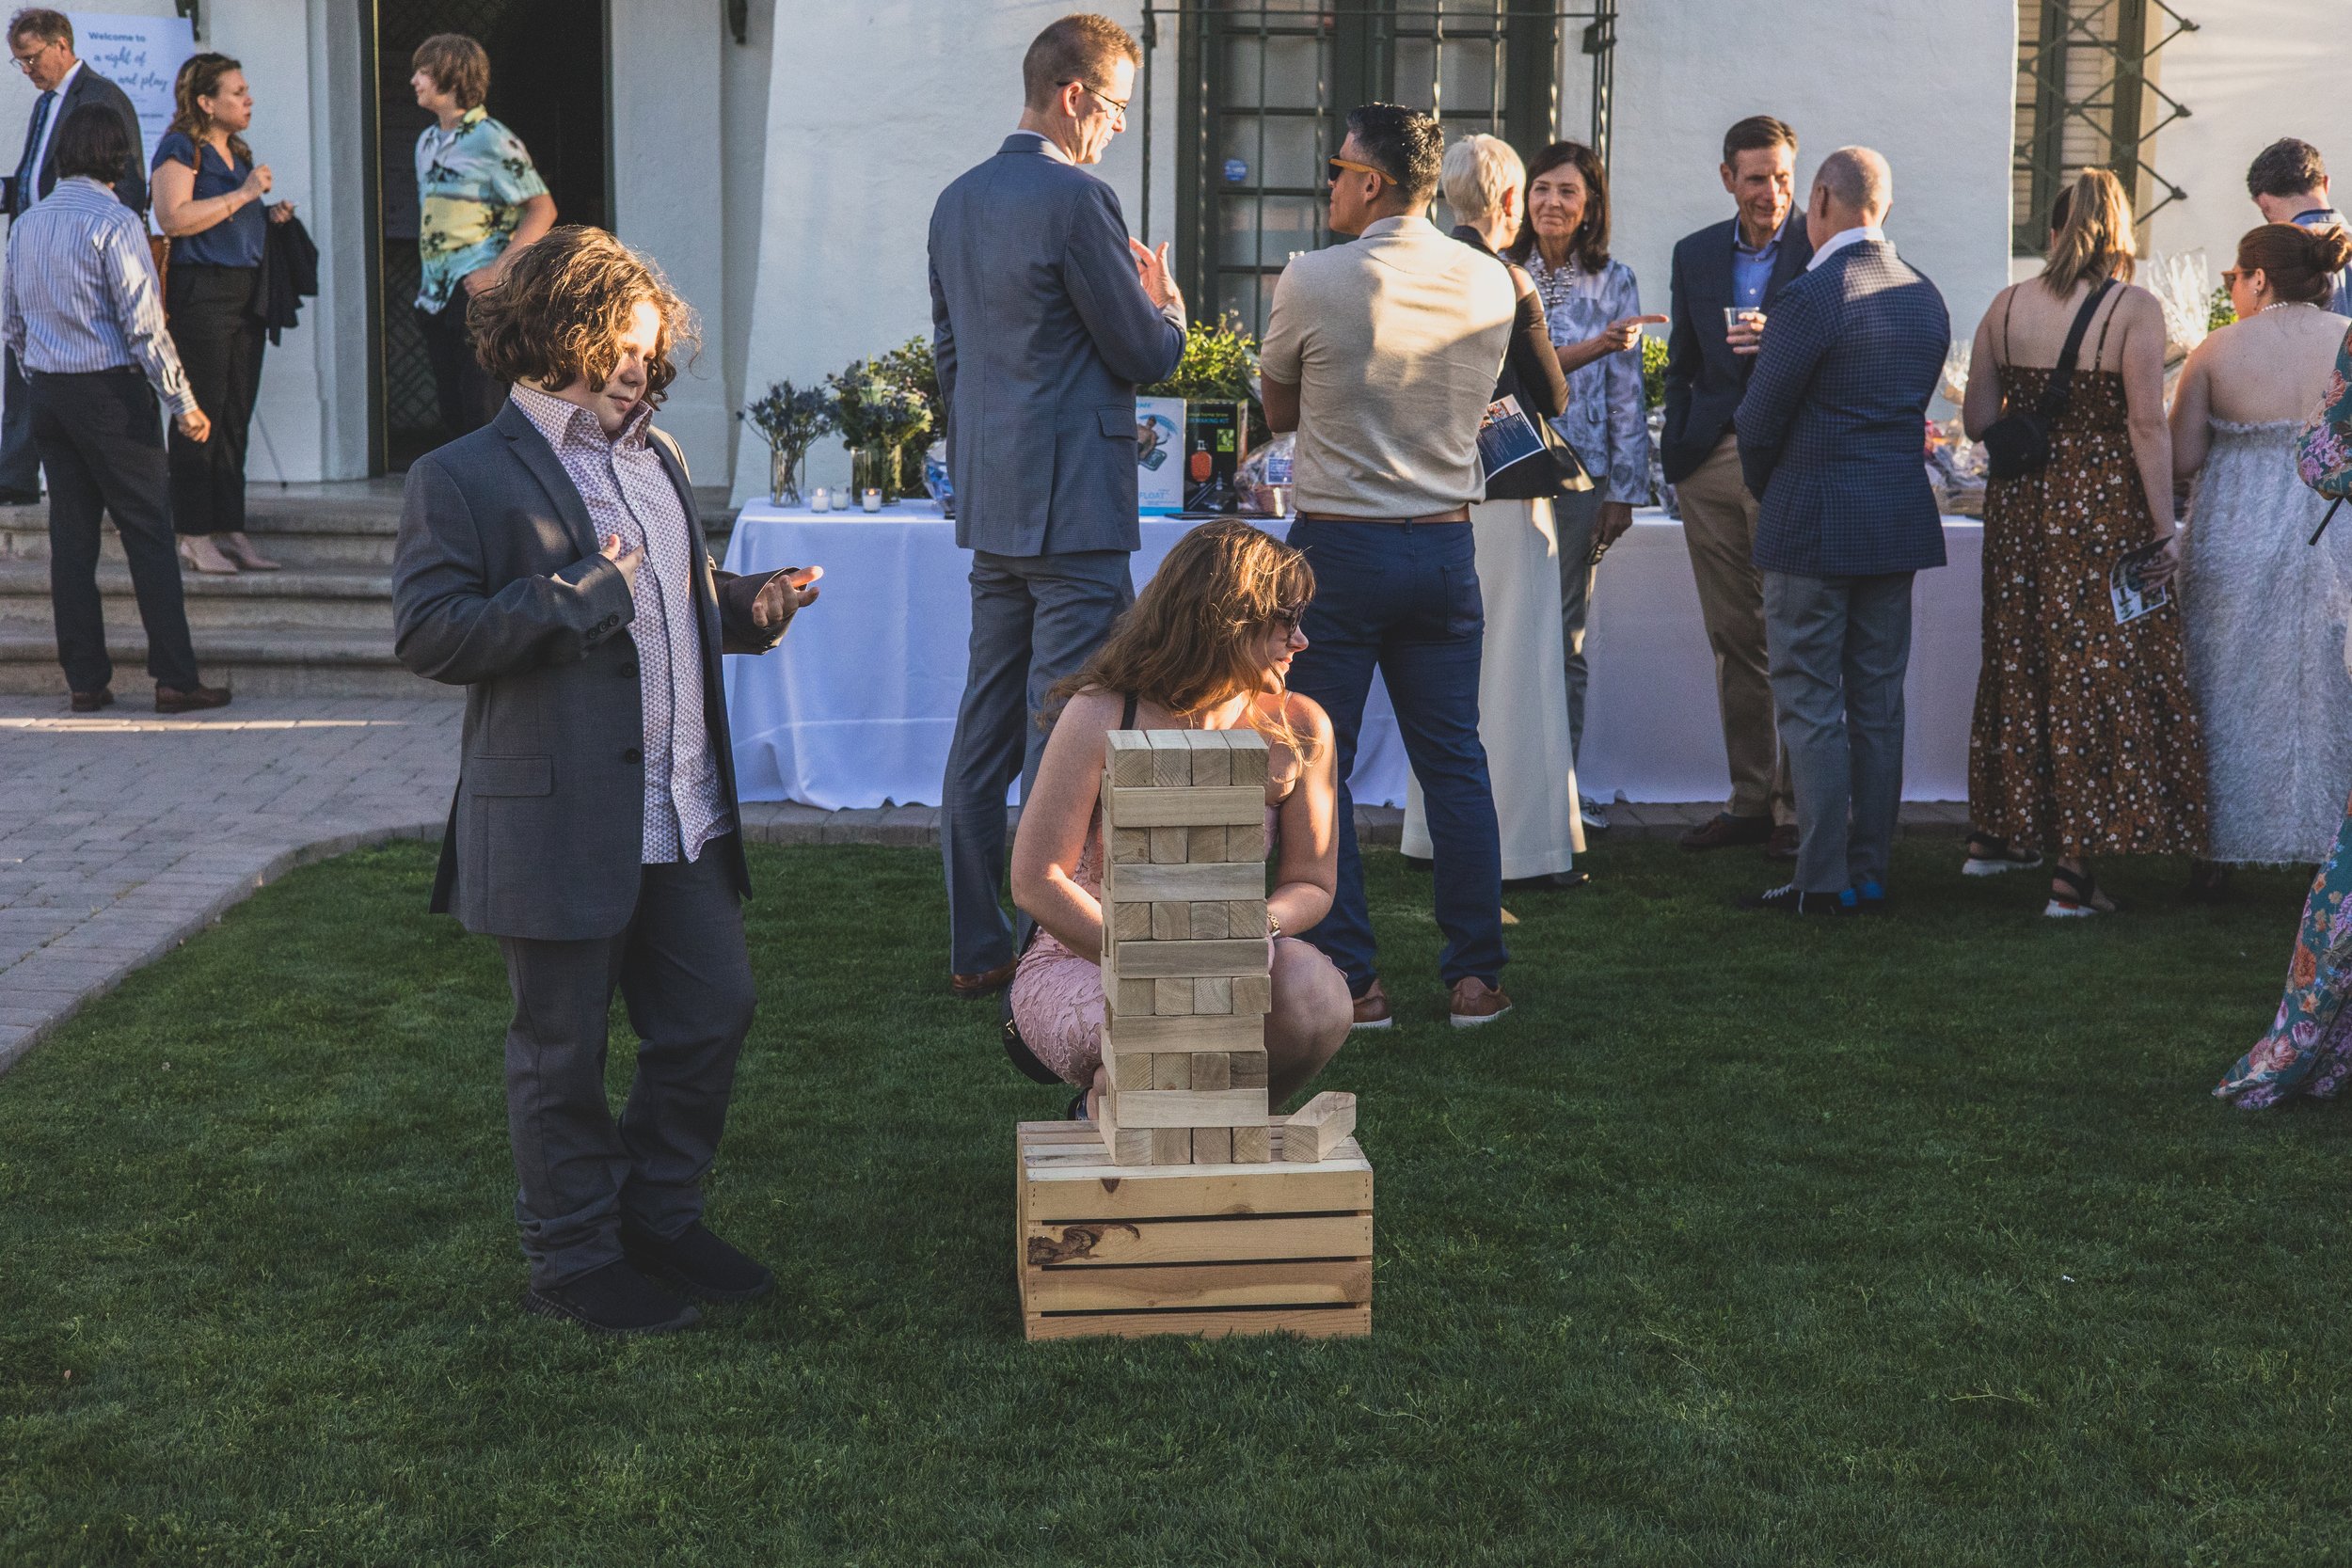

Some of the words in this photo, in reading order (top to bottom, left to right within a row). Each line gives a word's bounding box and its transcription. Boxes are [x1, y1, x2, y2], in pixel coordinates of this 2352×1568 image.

[88, 32, 134, 41] Welcome
[135, 34, 146, 42] to
[104, 46, 131, 68] night
[135, 51, 146, 66] of
[118, 72, 138, 85] and
[140, 71, 167, 92] play
